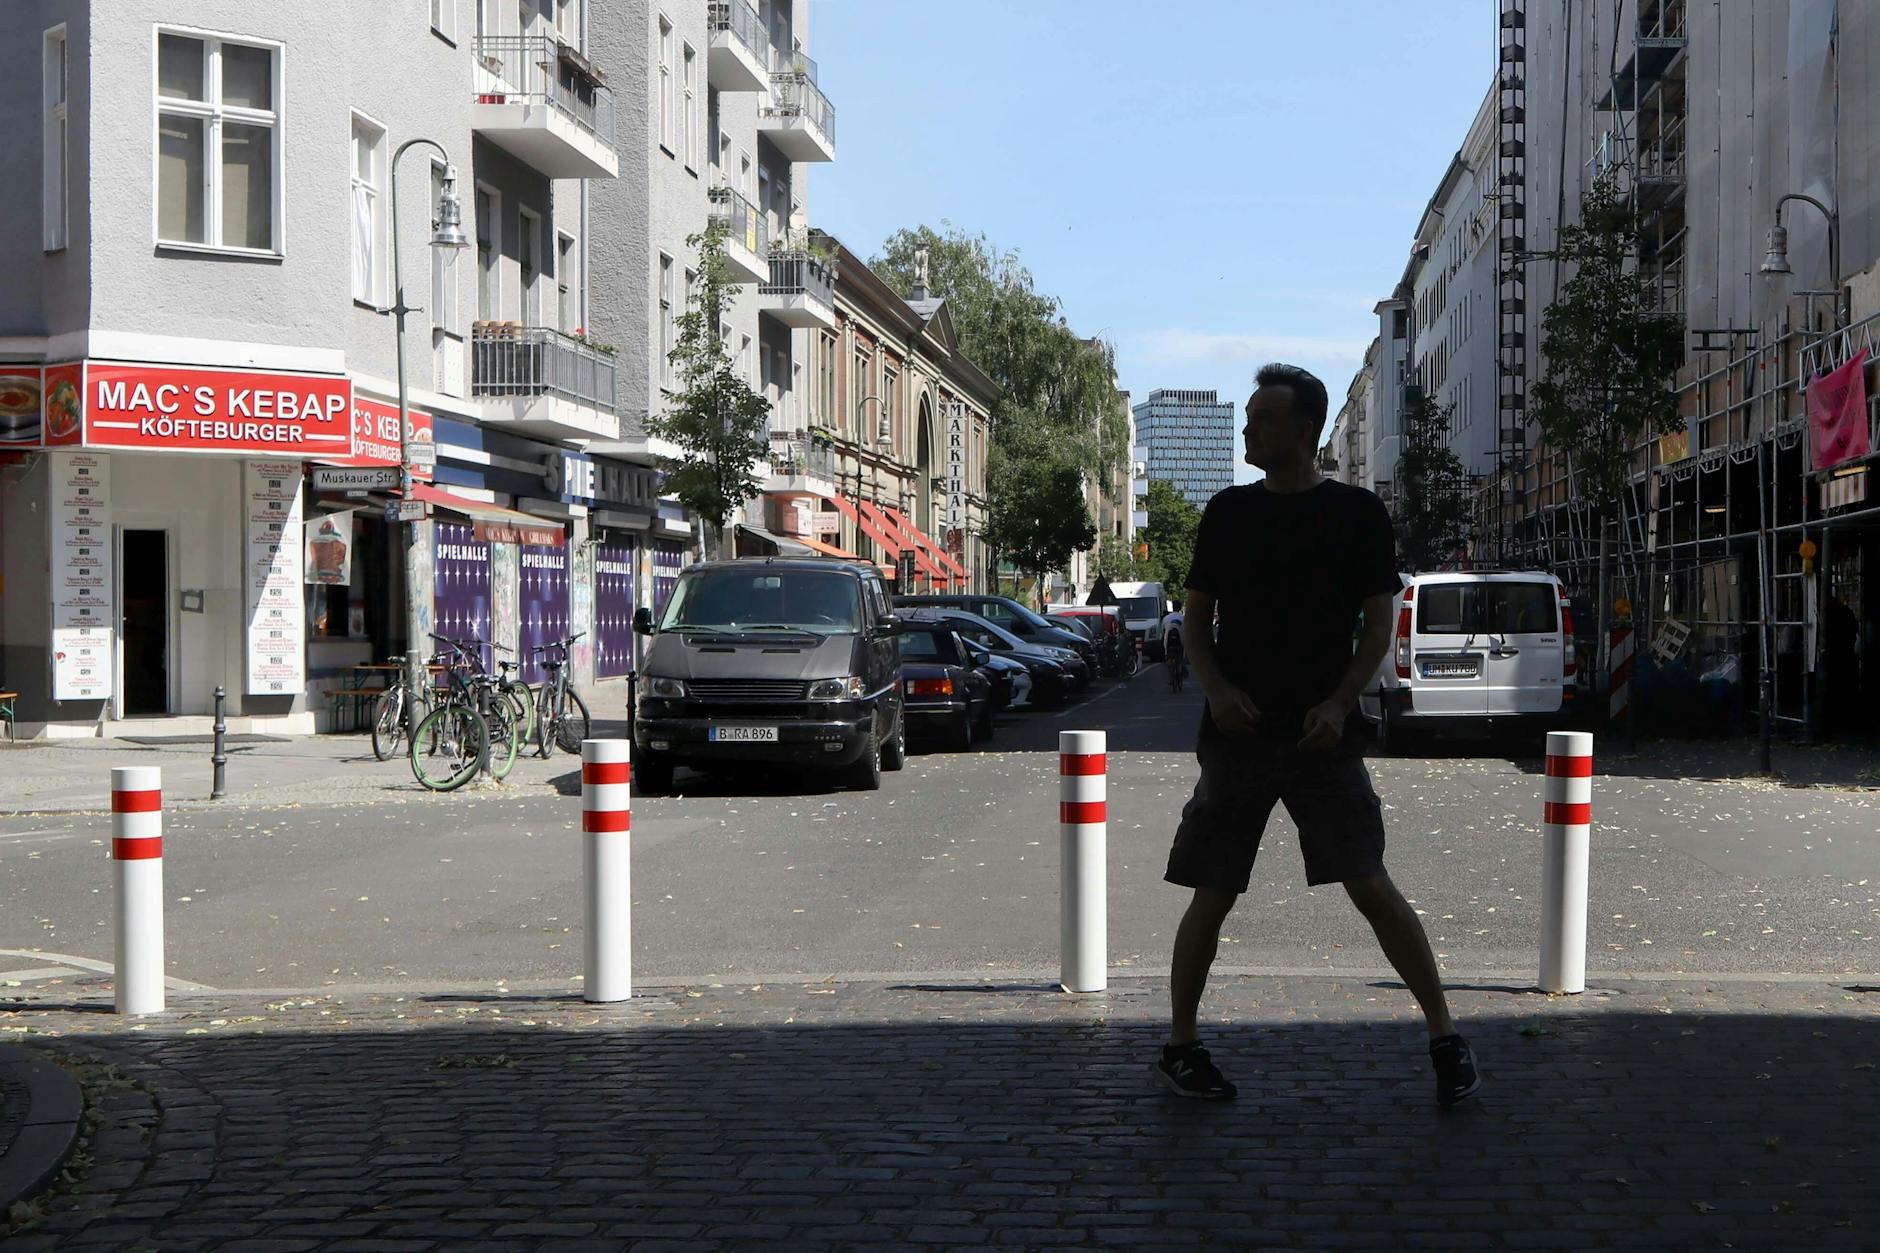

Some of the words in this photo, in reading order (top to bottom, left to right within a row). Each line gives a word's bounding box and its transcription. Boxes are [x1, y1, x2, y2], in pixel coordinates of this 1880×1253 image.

[228, 388, 346, 422] KEBAP
[140, 415, 303, 443] KÖFTEBURGER
[321, 472, 373, 484] Muskauer
[376, 471, 394, 484] Str.
[544, 453, 659, 509] SPIELHALL
[437, 543, 487, 562] SPIELHALLE
[522, 554, 565, 569] SPIELHALLE
[595, 560, 632, 575] SPIELHALLE
[719, 728, 727, 739] B
[734, 728, 749, 739] RA
[752, 728, 773, 739] 896
